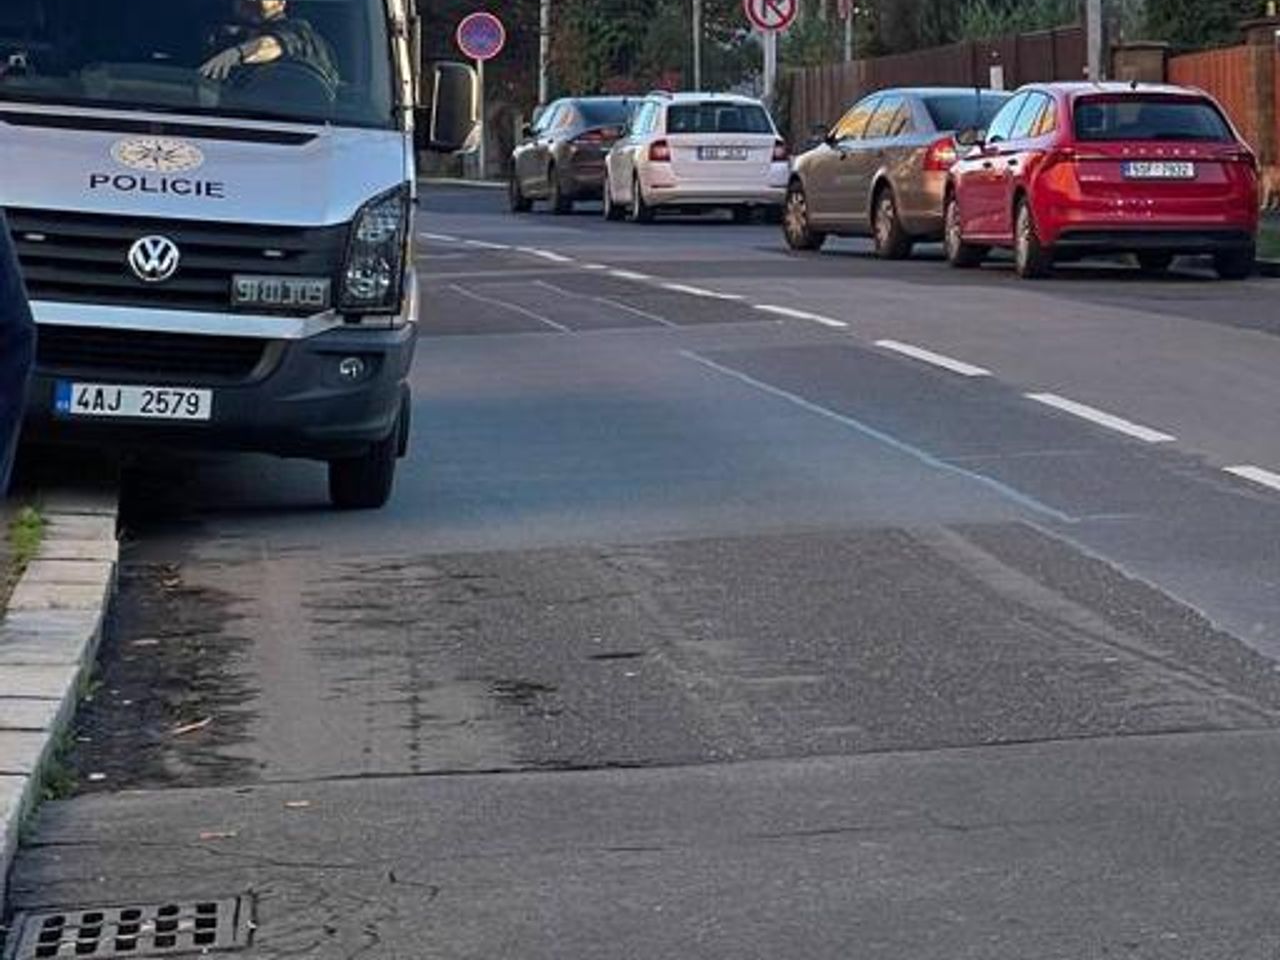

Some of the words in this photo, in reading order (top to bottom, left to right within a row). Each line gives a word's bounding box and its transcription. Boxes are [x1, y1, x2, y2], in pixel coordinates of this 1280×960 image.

[89, 174, 225, 199] POLICIE
[76, 387, 122, 412] 4AJ
[140, 390, 199, 415] 2579
